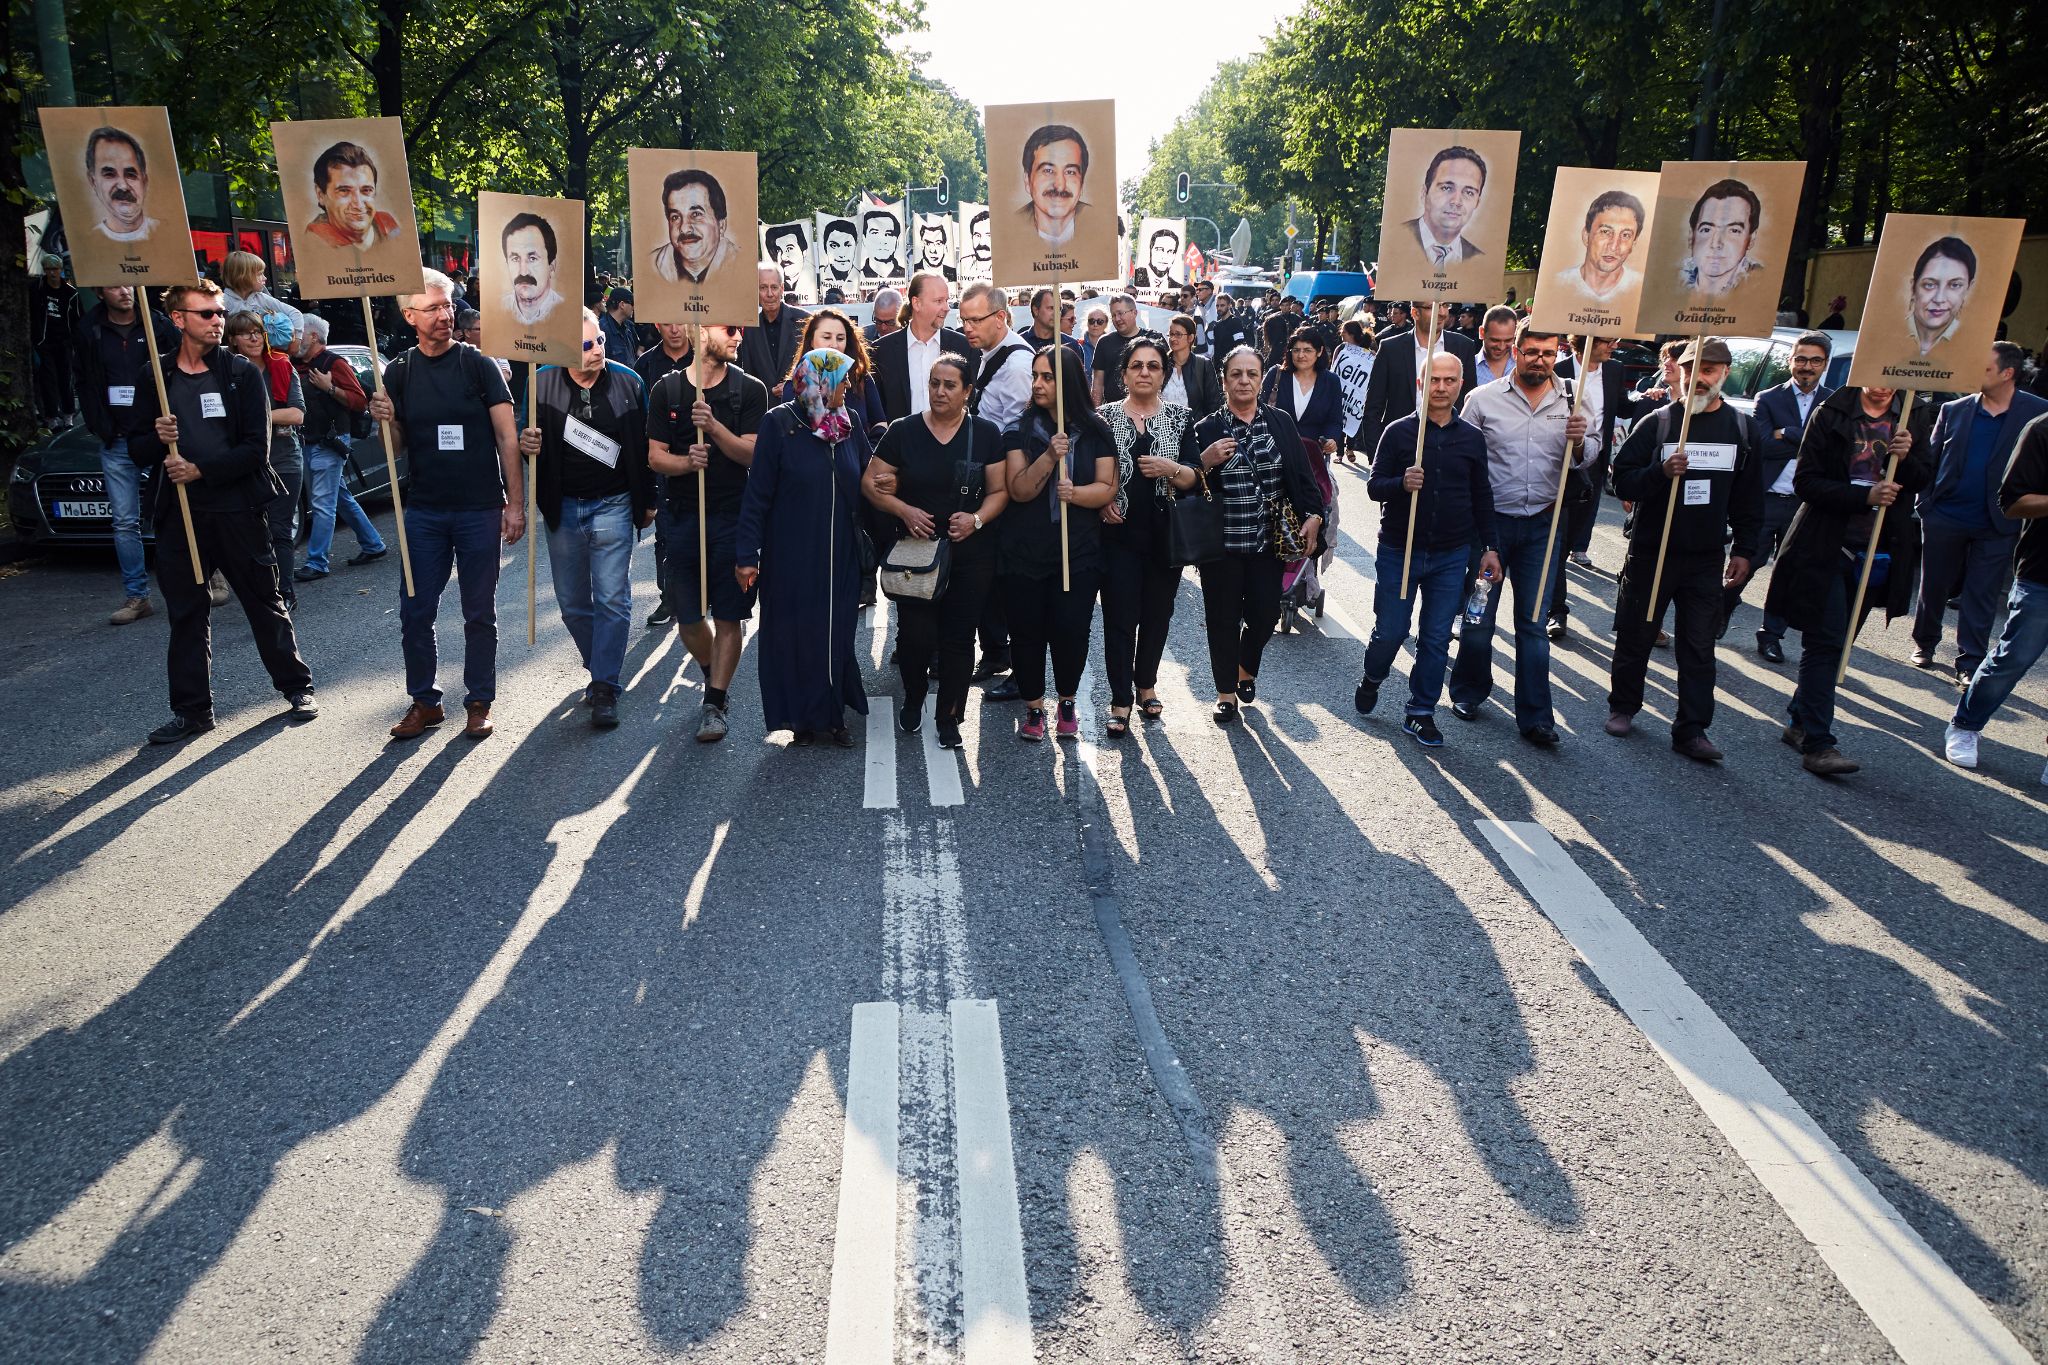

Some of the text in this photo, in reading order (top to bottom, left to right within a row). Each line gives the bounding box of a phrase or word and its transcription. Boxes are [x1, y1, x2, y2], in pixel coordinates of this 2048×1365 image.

[118, 263, 150, 275] Yaşar
[1032, 259, 1079, 272] Kubaşık
[327, 273, 396, 287] Boulgarides
[1421, 280, 1458, 291] Yozgat
[1567, 312, 1622, 327] Taşköprü
[1674, 310, 1737, 326] Özüdoğru
[514, 339, 548, 352] Şimşek
[1334, 353, 1369, 388] Kein
[1881, 366, 1955, 379] Kiesewetter
[63, 503, 73, 516] M
[79, 503, 97, 516] LG
